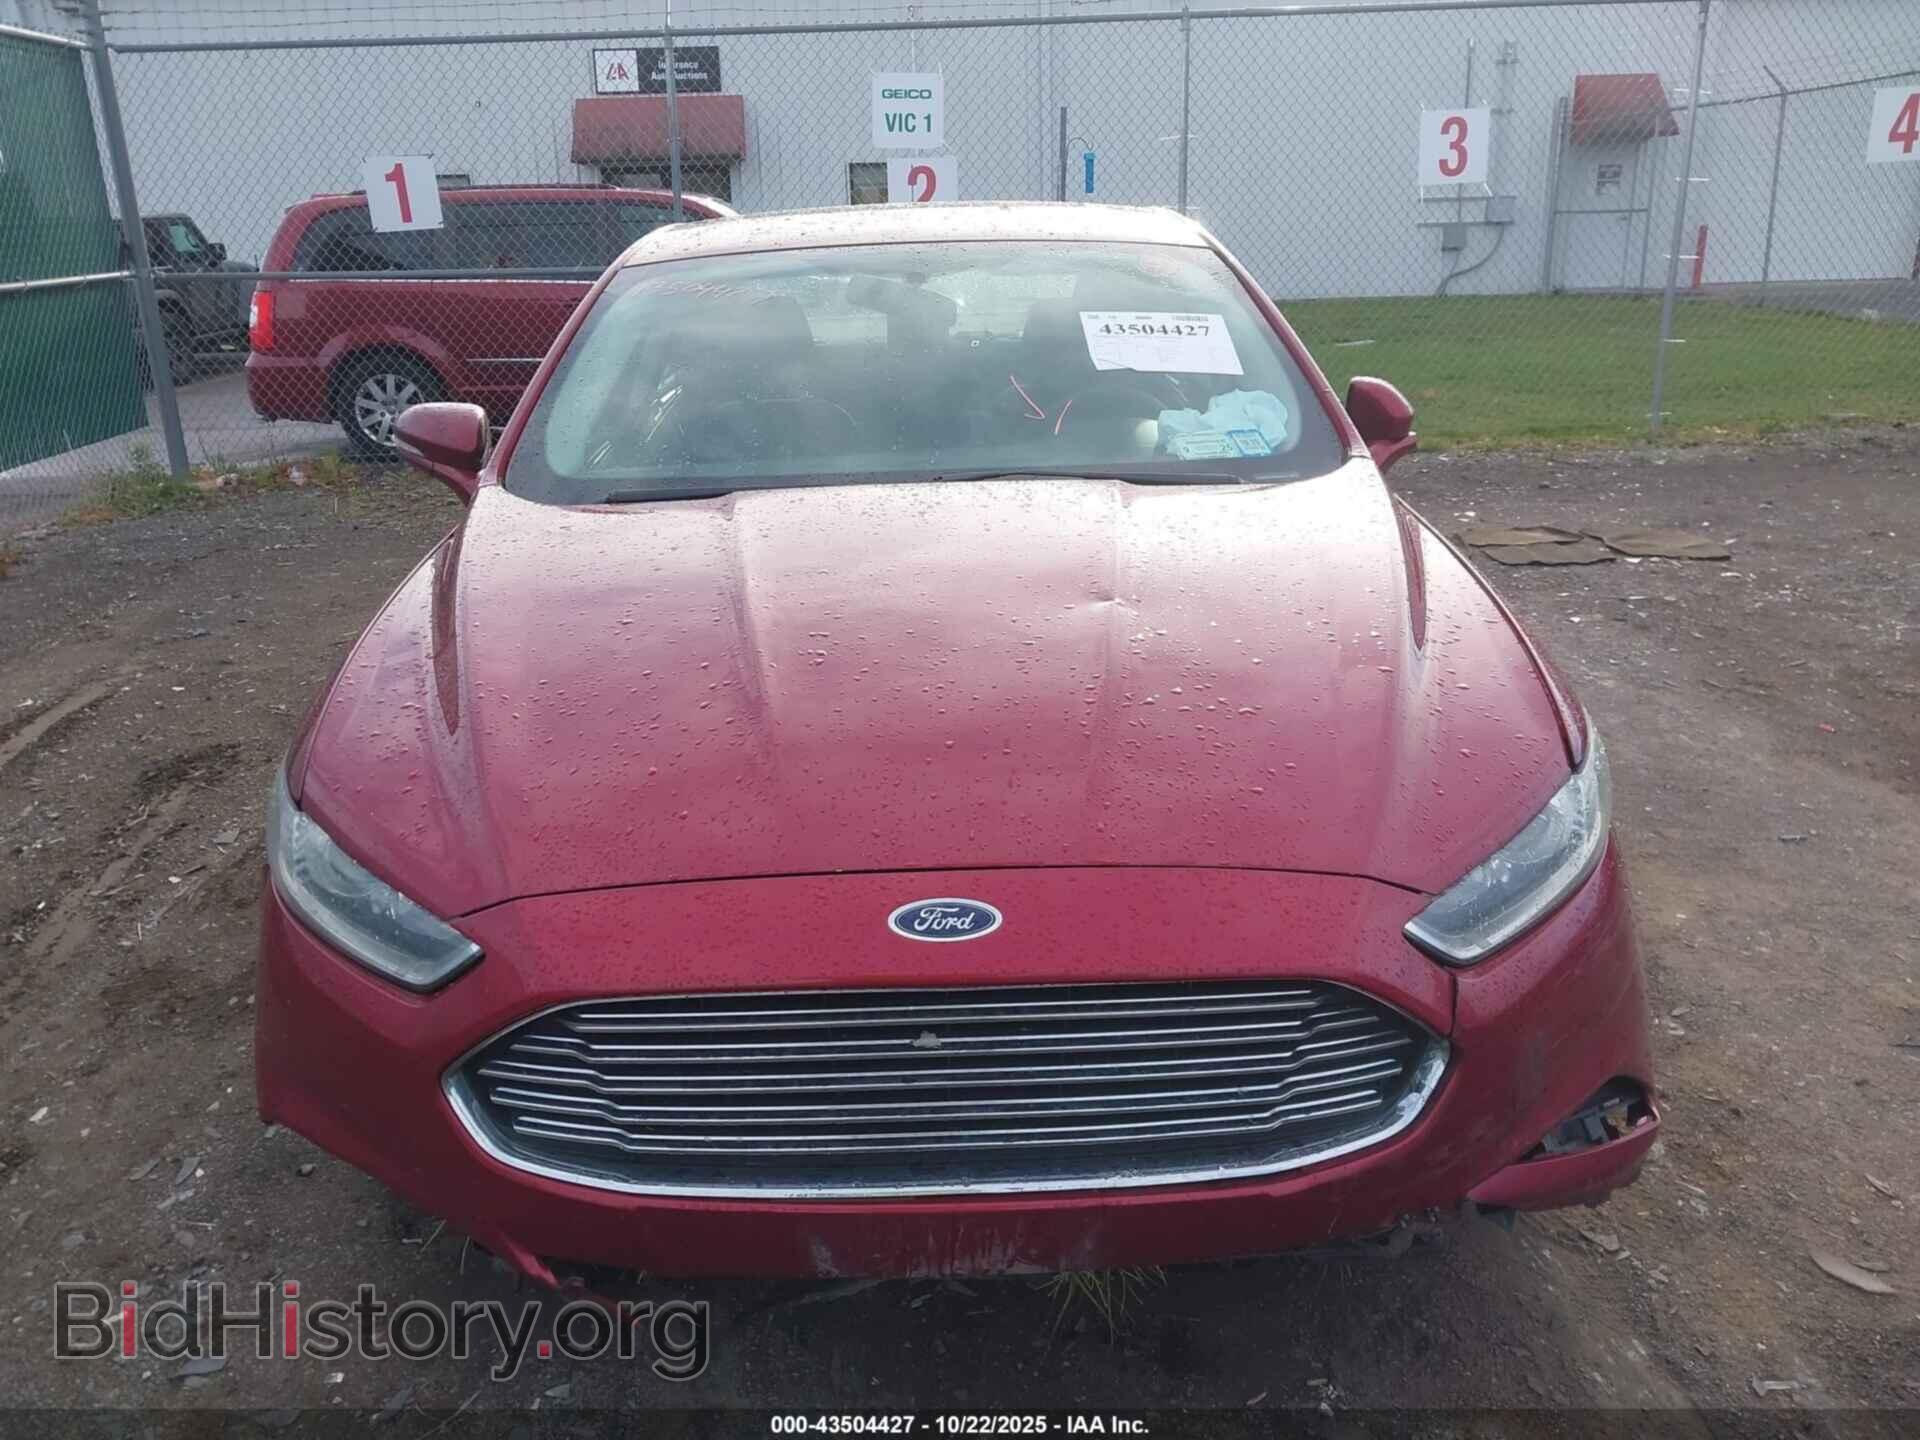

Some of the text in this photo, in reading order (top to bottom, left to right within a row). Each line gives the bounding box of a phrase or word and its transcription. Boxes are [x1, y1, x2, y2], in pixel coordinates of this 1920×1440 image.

[657, 60, 699, 69] Inrance
[881, 88, 932, 100] GEICO
[885, 112, 931, 132] VIC 1
[1887, 93, 1920, 154] 4
[1438, 116, 1468, 177] 3
[384, 163, 413, 224] 1
[907, 165, 937, 202] 2
[1100, 323, 1210, 337] 43504427
[913, 906, 975, 931] Ford
